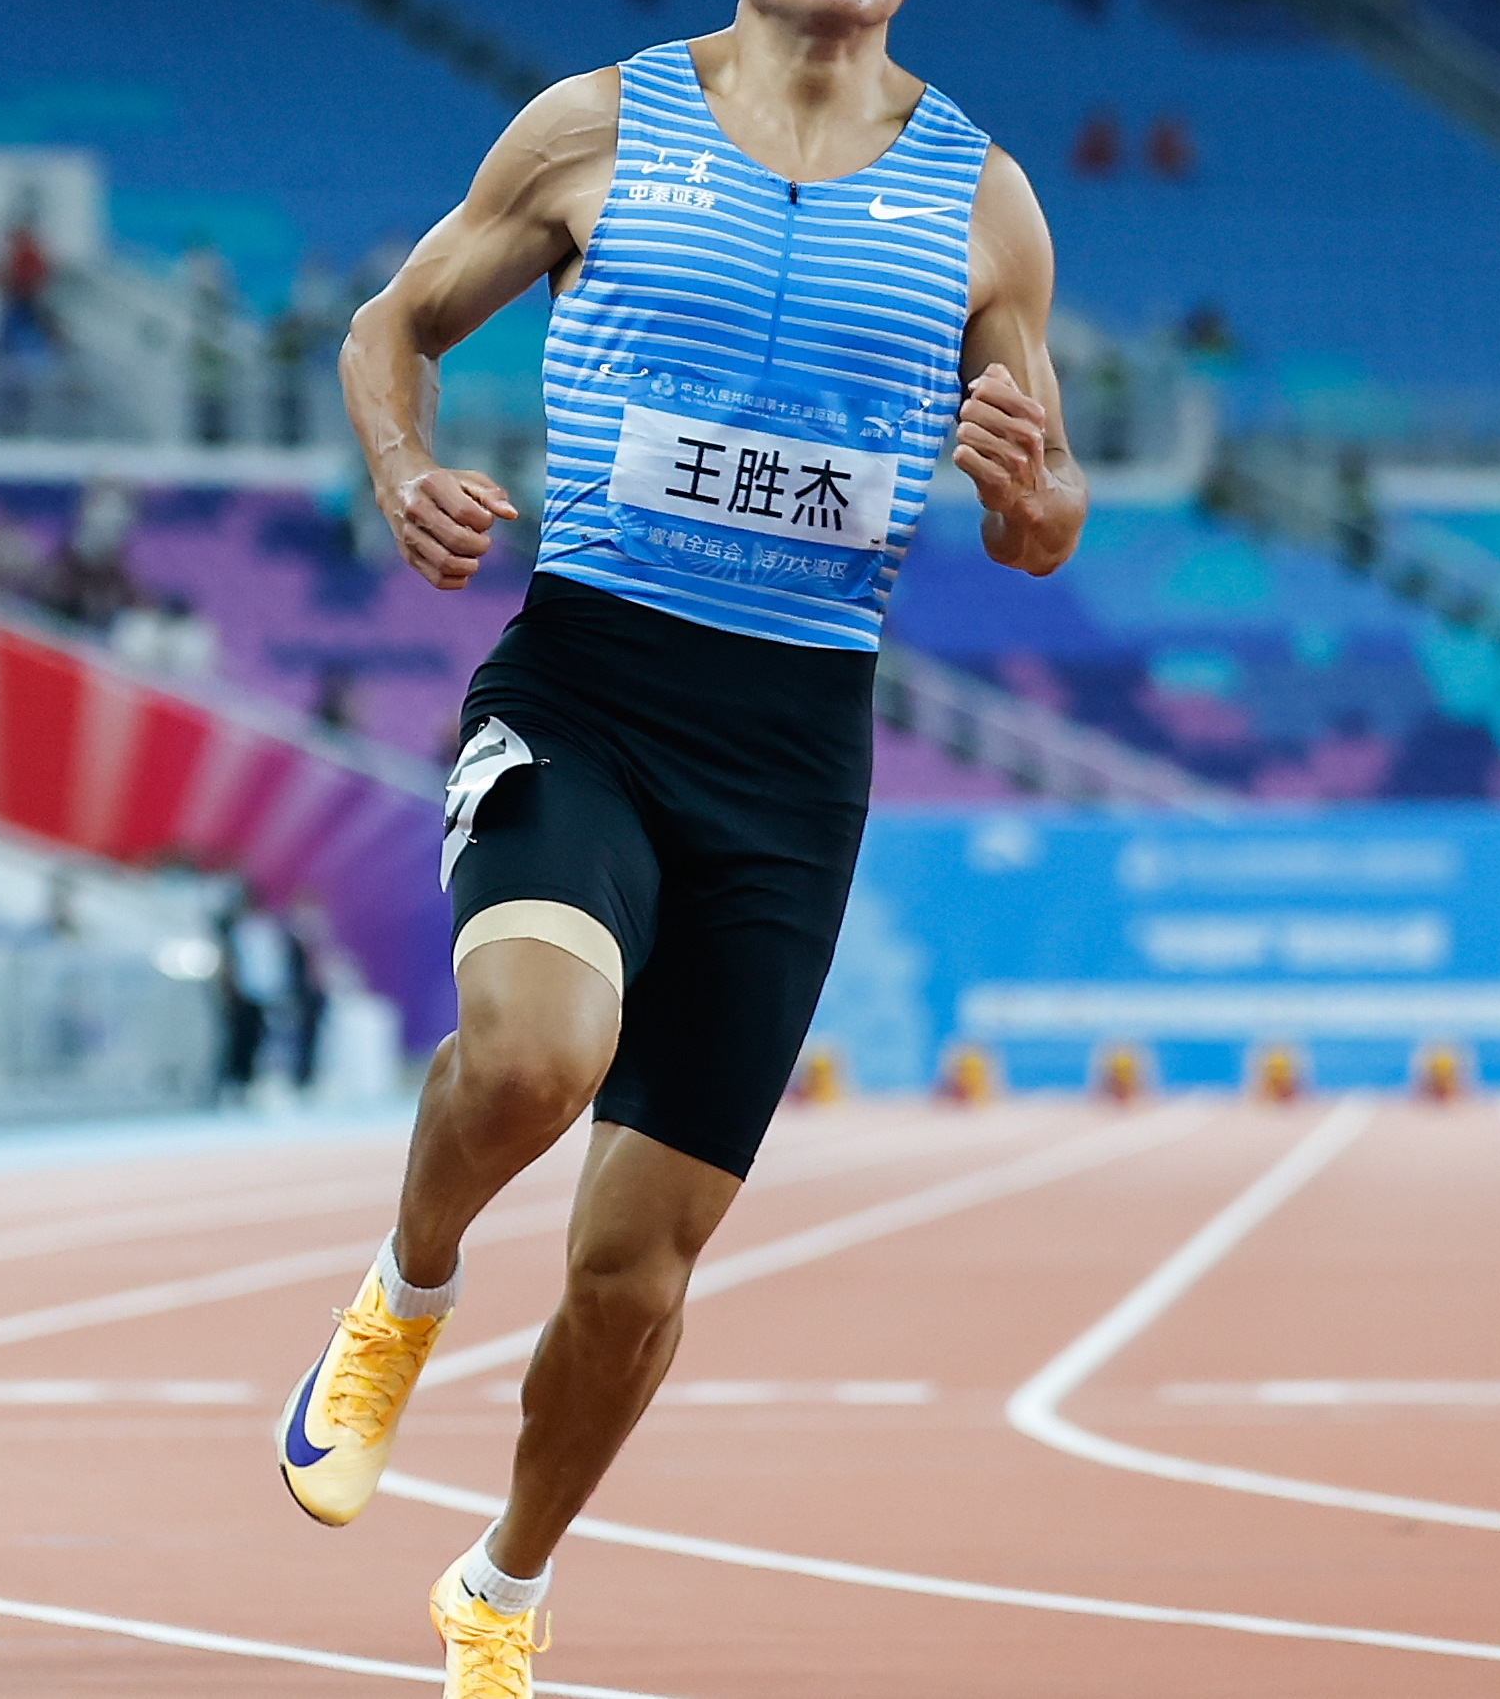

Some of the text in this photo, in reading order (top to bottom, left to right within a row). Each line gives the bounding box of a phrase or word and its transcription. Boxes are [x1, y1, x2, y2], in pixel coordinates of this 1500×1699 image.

[641, 149, 716, 183] 山东
[628, 184, 716, 210] 中泰证券
[665, 436, 852, 531] 王胜杰
